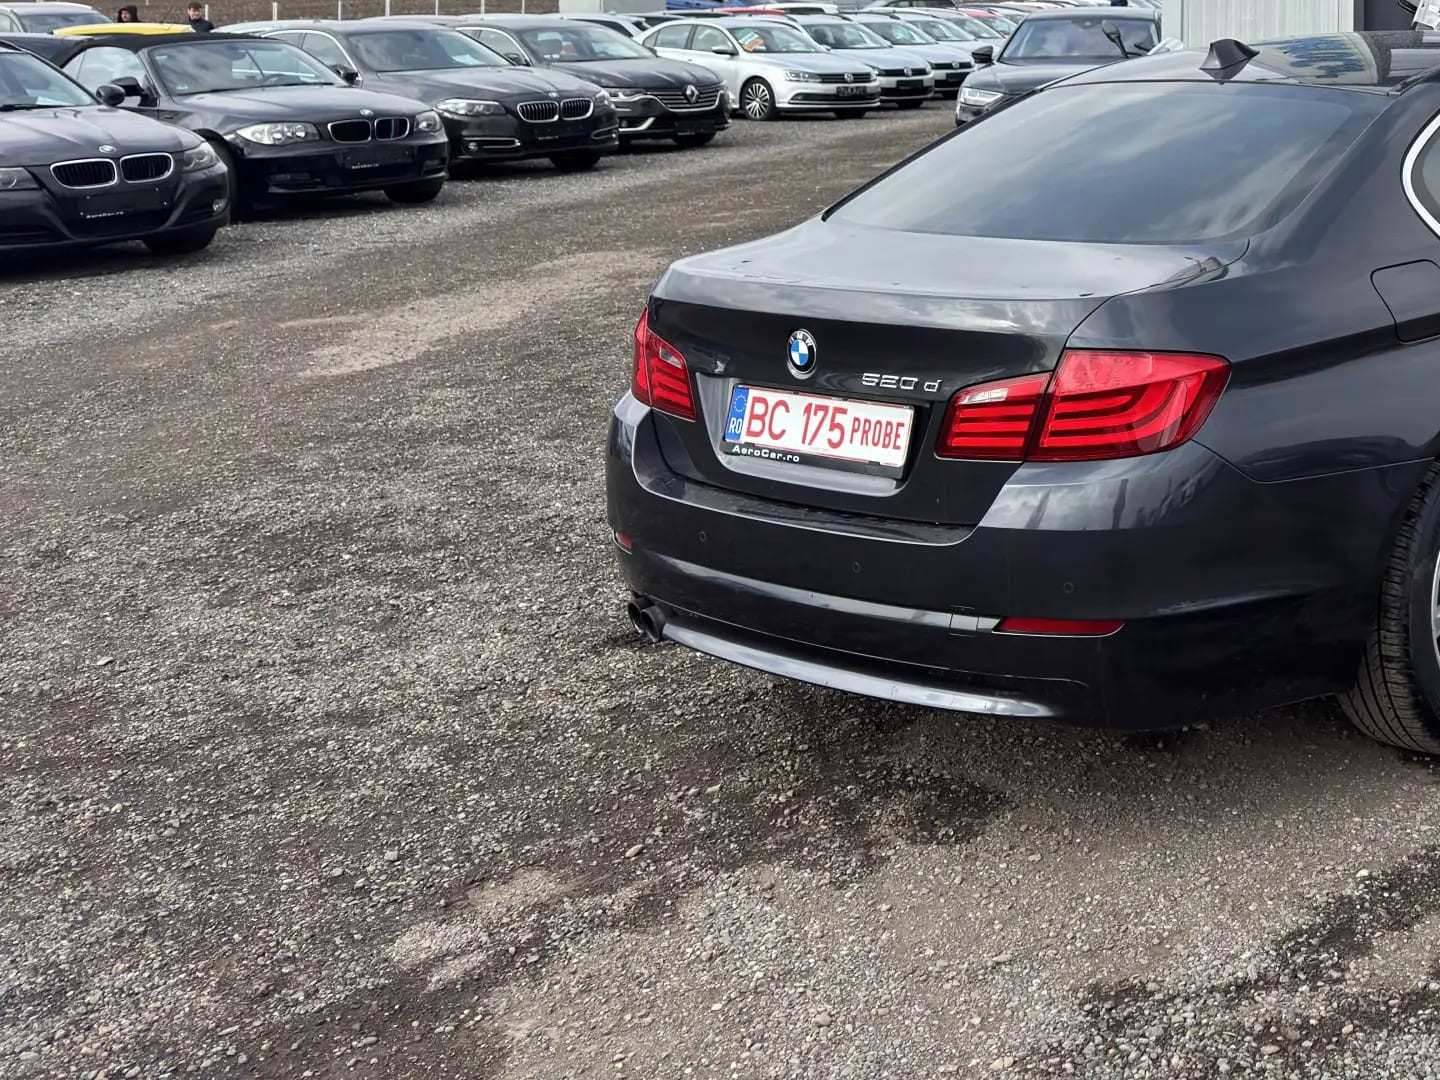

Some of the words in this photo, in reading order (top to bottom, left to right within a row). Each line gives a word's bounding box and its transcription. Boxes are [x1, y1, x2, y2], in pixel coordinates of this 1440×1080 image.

[728, 417, 742, 434] RO
[745, 395, 790, 441] BC
[801, 402, 848, 449] 175
[849, 416, 905, 450] PROBE
[732, 444, 800, 463] AeroCar.ro
